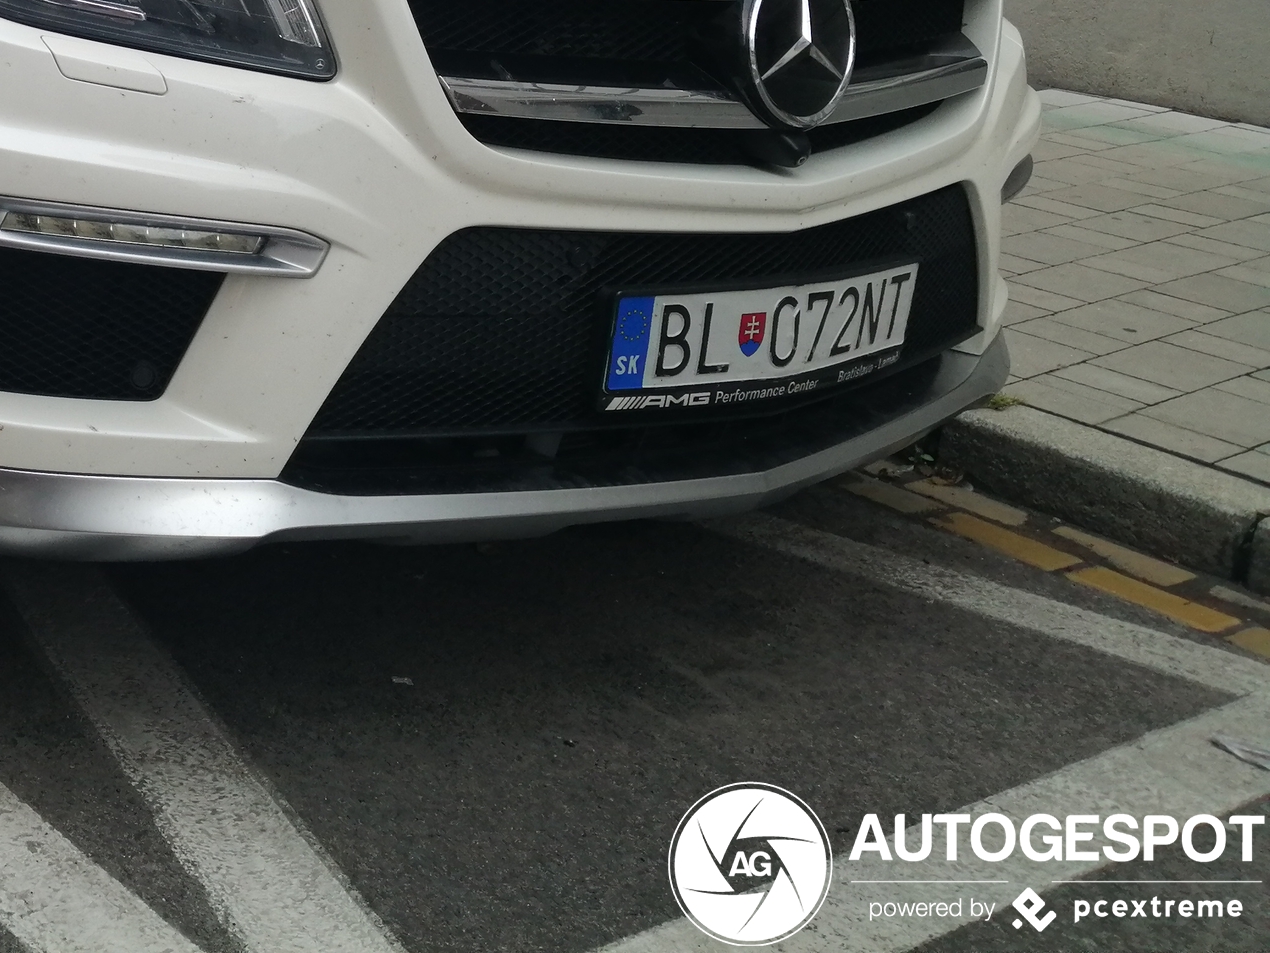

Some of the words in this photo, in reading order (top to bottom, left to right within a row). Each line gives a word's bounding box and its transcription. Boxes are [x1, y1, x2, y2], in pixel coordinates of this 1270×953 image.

[654, 302, 730, 378] BL
[615, 355, 640, 375] SK
[715, 384, 784, 403] Performance
[787, 378, 819, 394] Center
[837, 365, 873, 382] Bratislava
